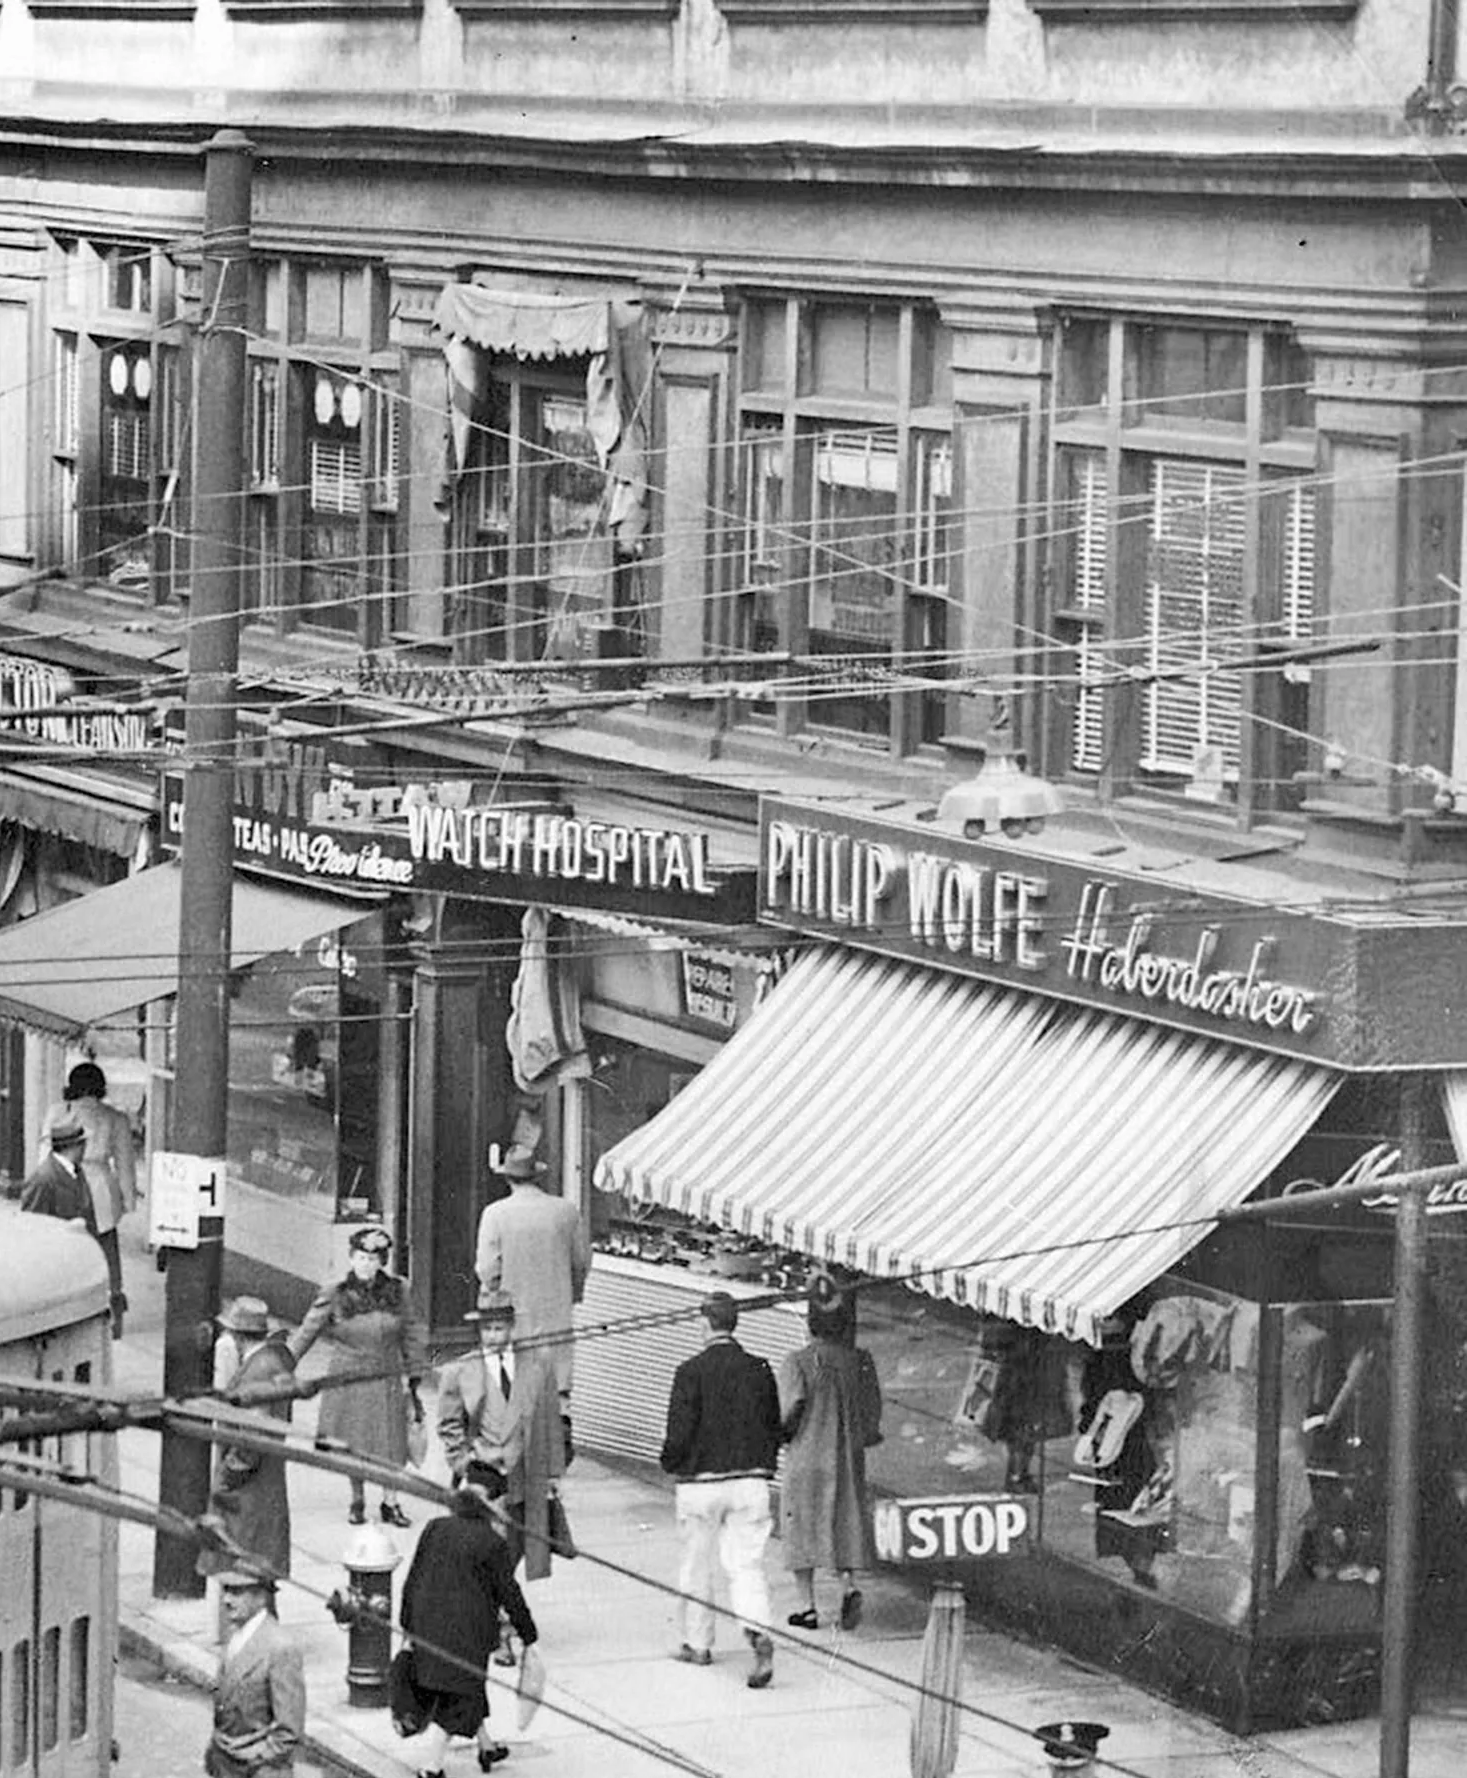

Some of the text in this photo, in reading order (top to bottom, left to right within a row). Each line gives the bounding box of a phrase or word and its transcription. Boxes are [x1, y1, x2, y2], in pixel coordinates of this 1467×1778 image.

[232, 816, 271, 855] TEAS
[303, 834, 414, 883] Providence
[408, 804, 522, 874] WATCH
[533, 815, 716, 893] HOSPITAL
[768, 821, 1315, 1032] PHILIP WOLFE Haberdasher
[907, 1503, 1028, 1559] STOP
